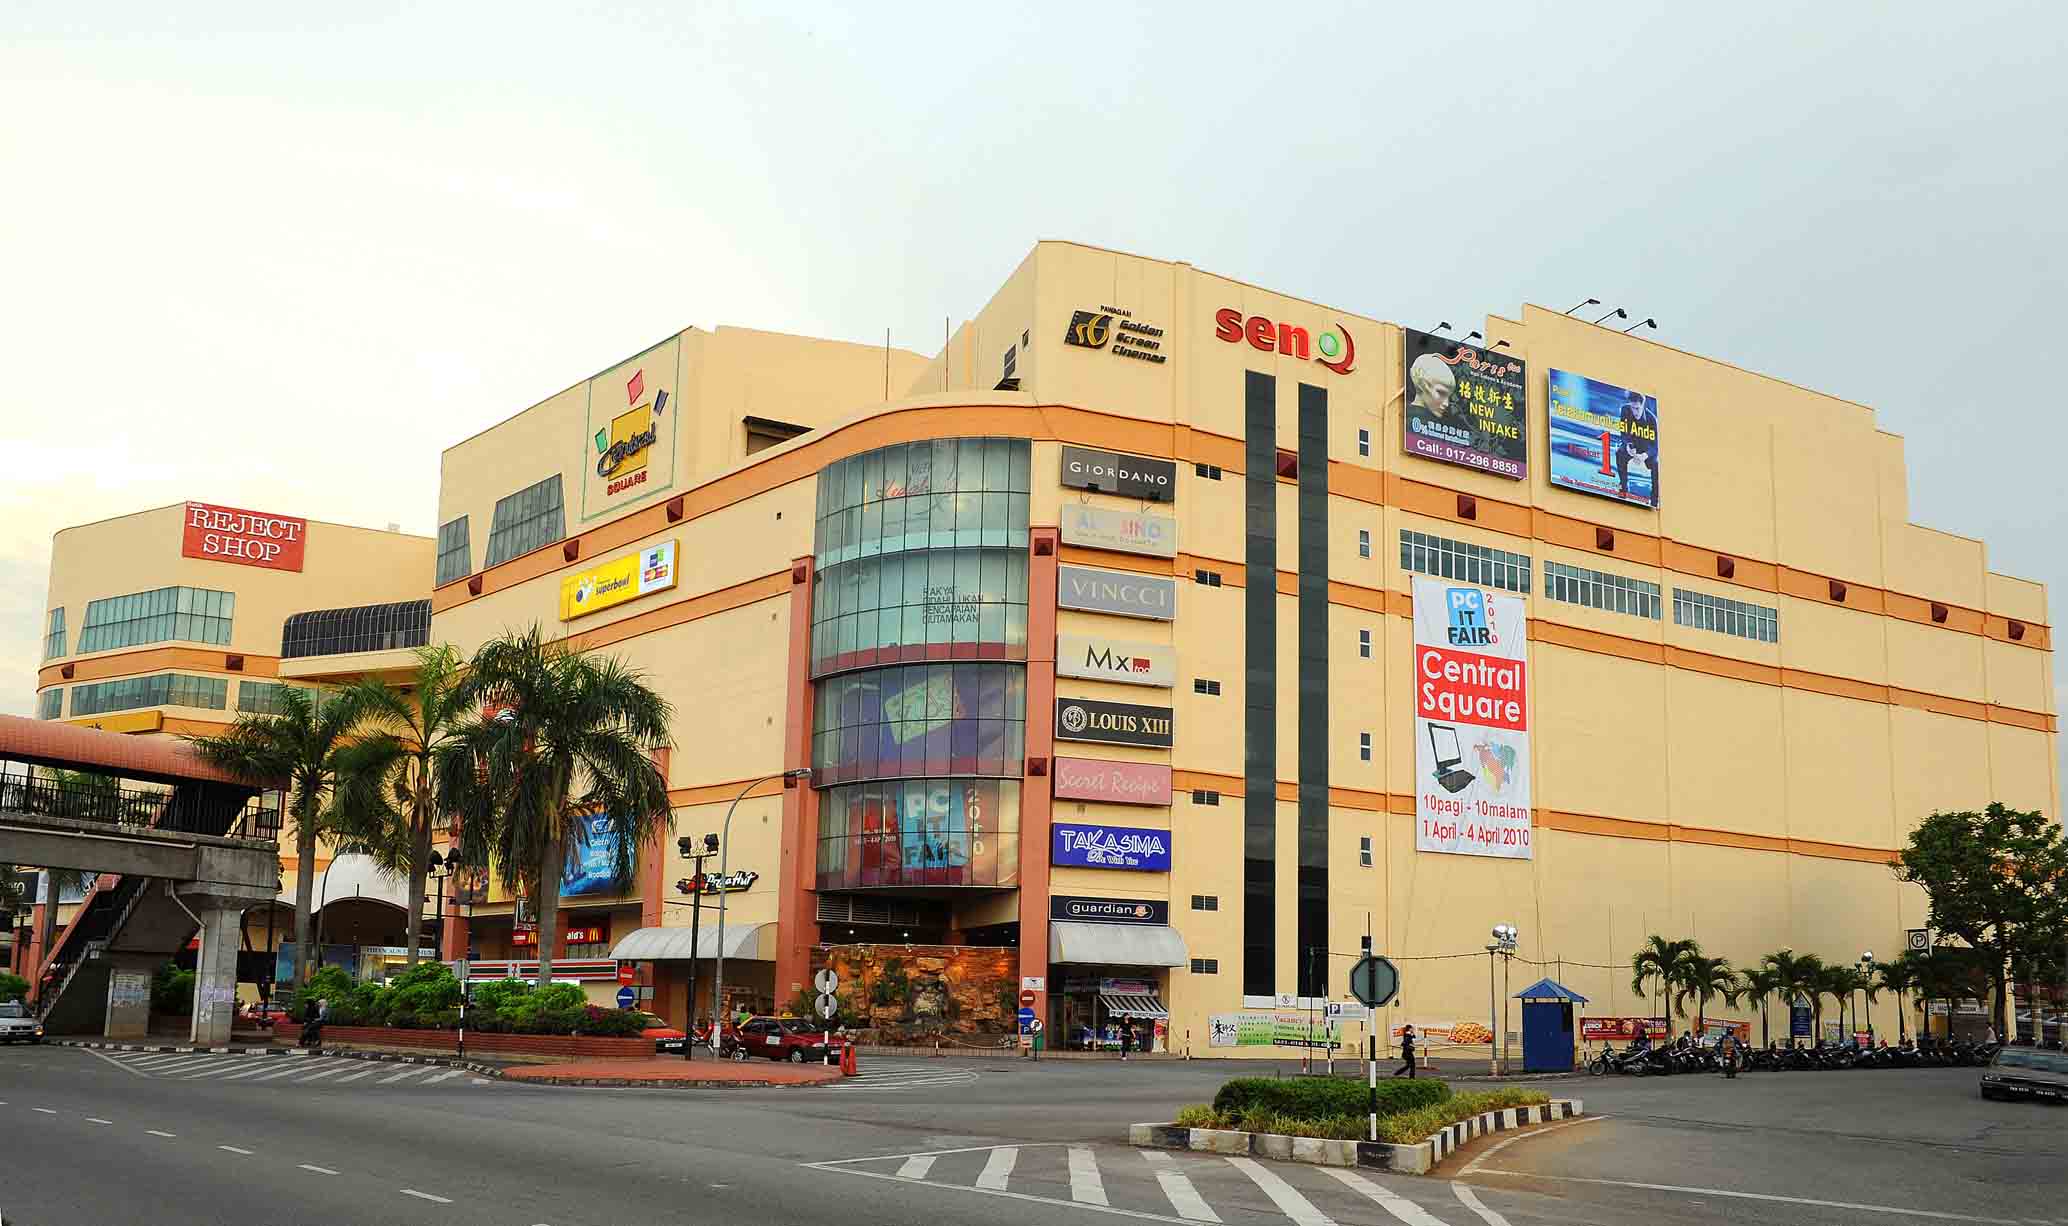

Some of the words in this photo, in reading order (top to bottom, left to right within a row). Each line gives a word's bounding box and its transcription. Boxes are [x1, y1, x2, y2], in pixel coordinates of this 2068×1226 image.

[1116, 332, 1161, 350] Screen
[1120, 320, 1164, 338] Golden
[1111, 344, 1167, 364] Cinemas
[1470, 402, 1495, 419] NEW
[1480, 419, 1518, 439] INTAKE
[1631, 423, 1655, 441] Anda
[1416, 440, 1443, 456] Call:
[1446, 447, 1490, 468] 017-296
[1493, 459, 1518, 474] 8858
[1598, 431, 1616, 477] 1
[607, 470, 648, 496] SQUARE
[1069, 461, 1168, 486] GIORDANO
[189, 507, 301, 541] REJECT
[203, 533, 281, 561] SHOP
[1071, 578, 1168, 608] VINCCI
[1451, 591, 1480, 609] PC
[1459, 610, 1475, 626] IT
[1447, 627, 1491, 645] FAIR
[1086, 644, 1130, 672] Mx
[1422, 650, 1521, 692] Central
[1422, 682, 1521, 723] Square
[1088, 712, 1137, 732] LOUIS
[1140, 717, 1170, 735] XIII
[1060, 768, 1105, 792] Secret
[1111, 769, 1160, 797] Recipe
[1424, 794, 1463, 817] 10pagi
[1475, 800, 1528, 820] 10malam
[1060, 829, 1166, 858] TAKASIMA
[1432, 821, 1457, 843] April
[1467, 823, 1475, 841] 4
[1477, 825, 1501, 847] April
[1503, 828, 1529, 846] 2010
[1072, 904, 1133, 915] guardian
